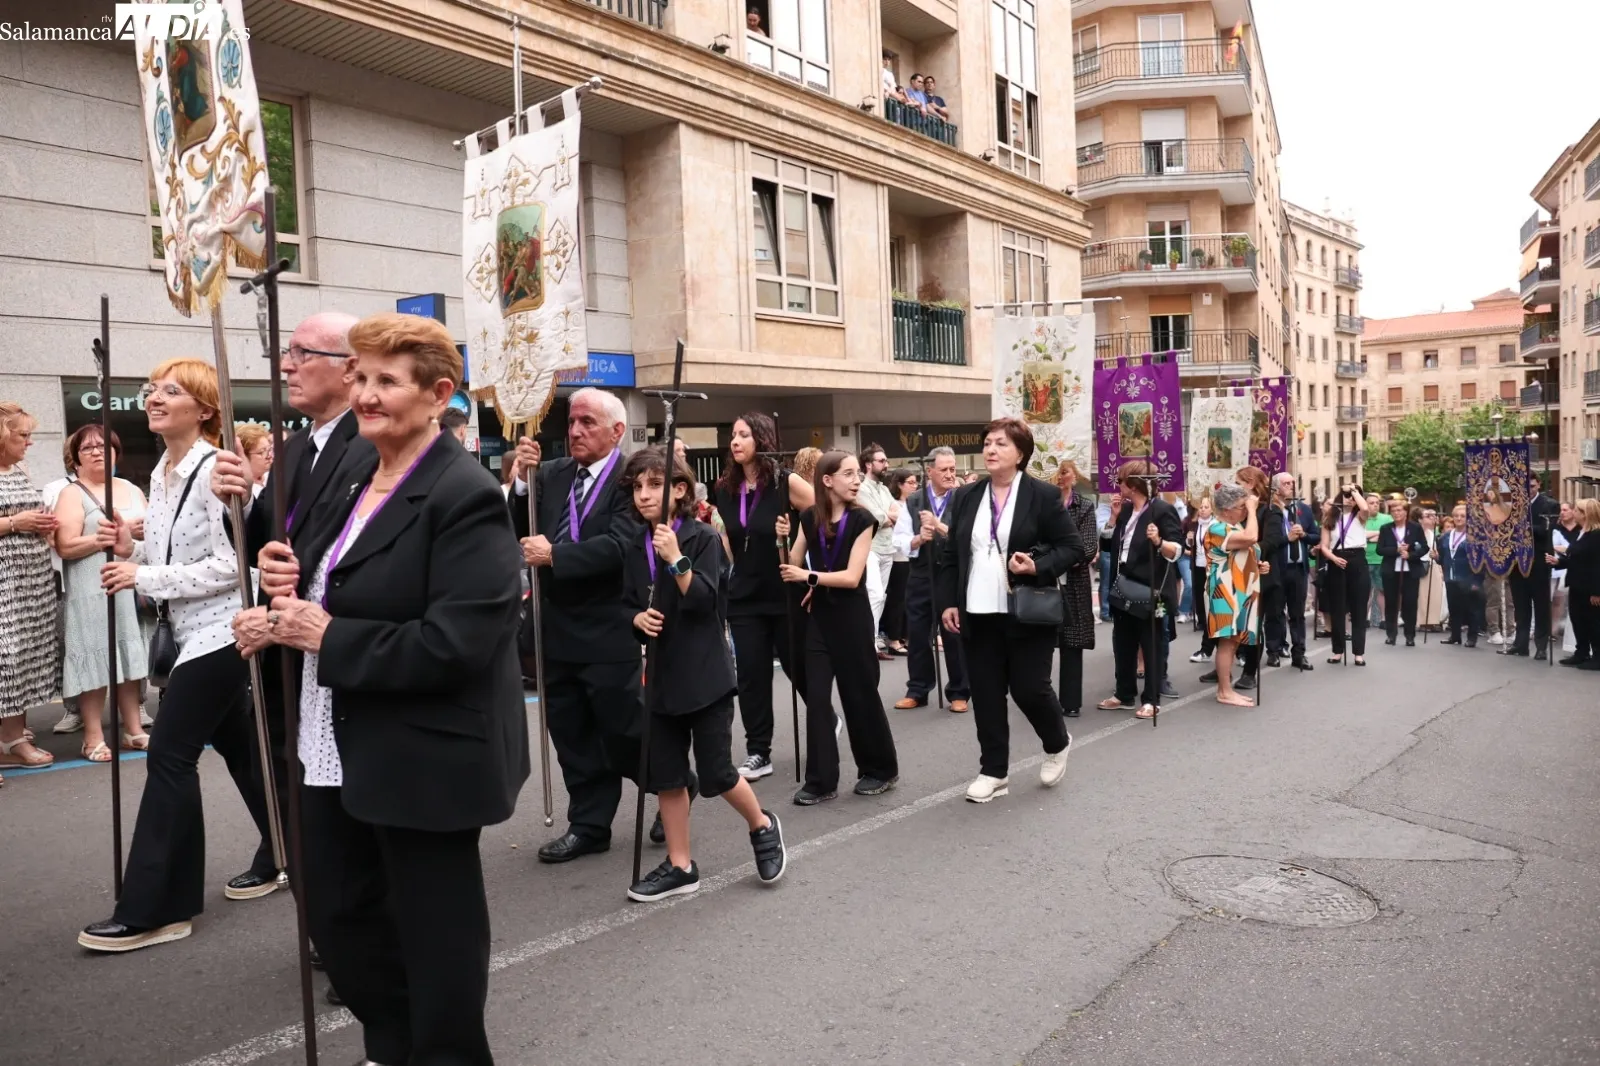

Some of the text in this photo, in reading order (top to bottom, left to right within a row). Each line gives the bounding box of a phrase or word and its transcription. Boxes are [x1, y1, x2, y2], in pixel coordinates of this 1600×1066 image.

[588, 359, 618, 374] TICA
[80, 391, 147, 411] Cart
[634, 429, 645, 441] 18
[927, 433, 981, 447] BARBER SHOP
